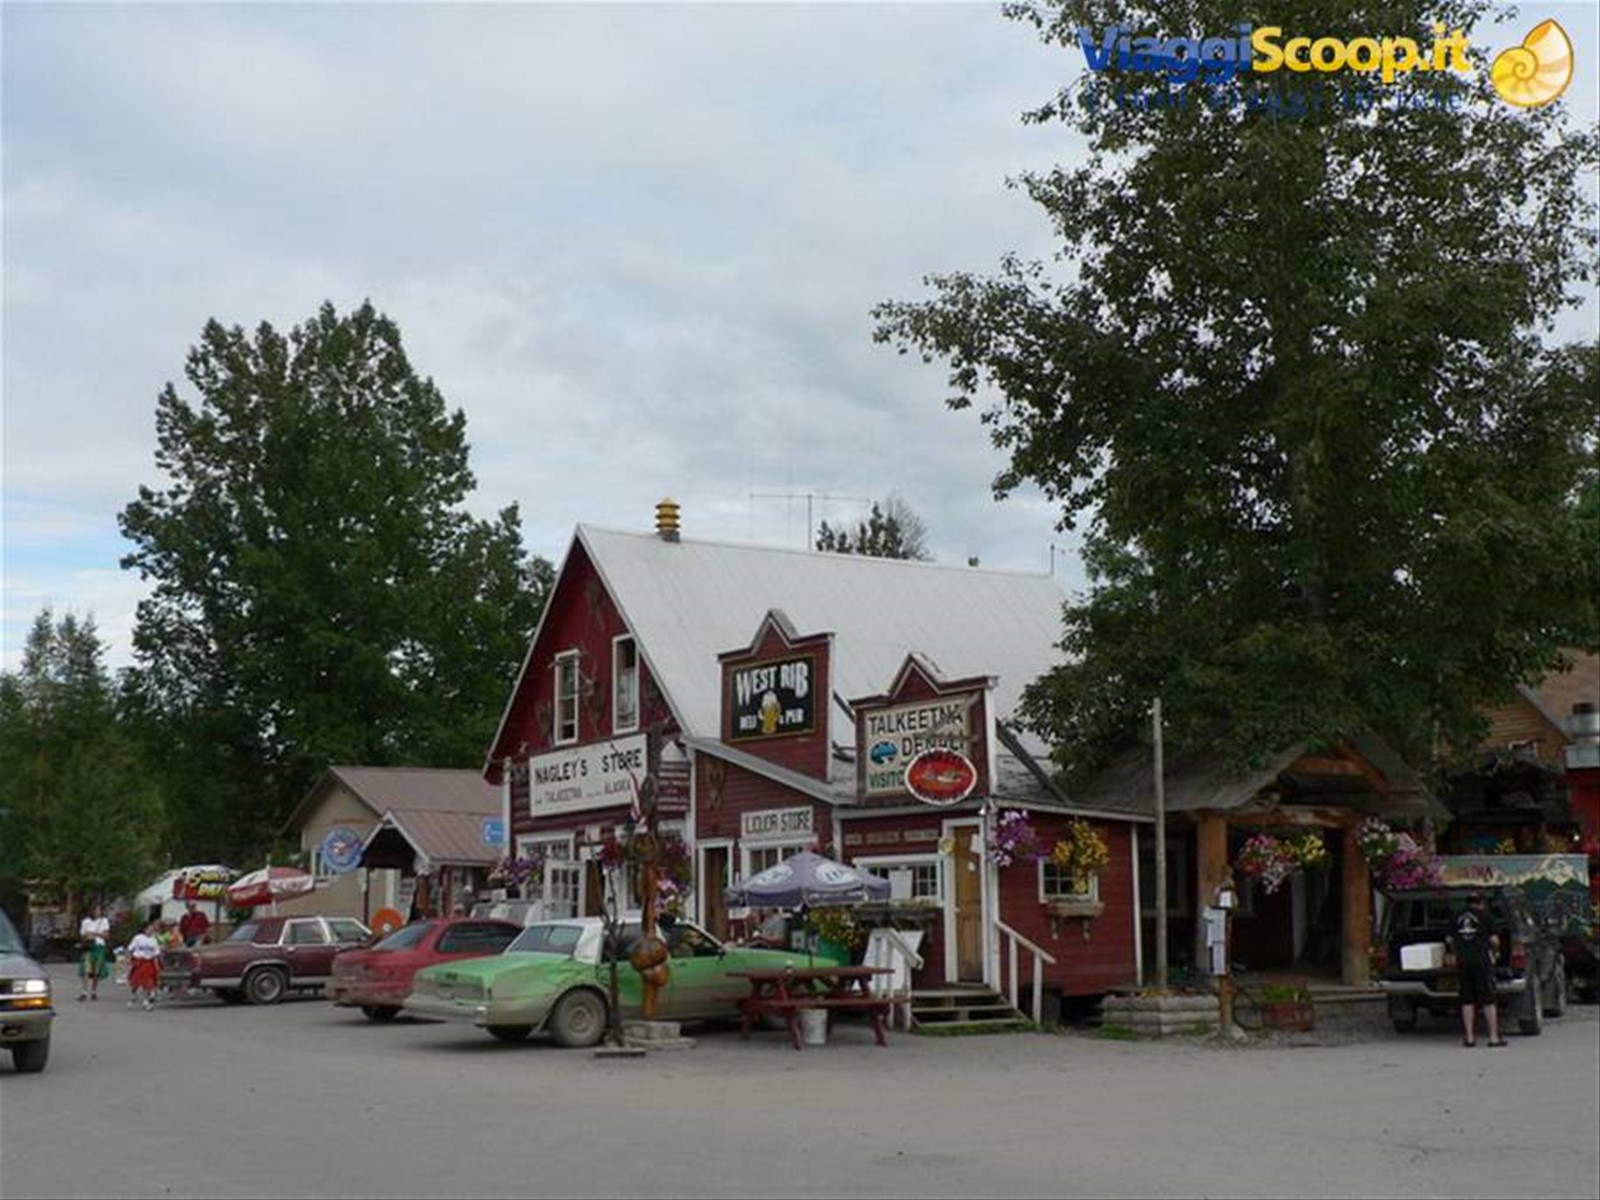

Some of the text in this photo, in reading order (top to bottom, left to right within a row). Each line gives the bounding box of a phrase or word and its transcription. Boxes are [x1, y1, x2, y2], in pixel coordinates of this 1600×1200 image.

[736, 661, 809, 706] WEST RIB
[868, 704, 964, 737] TALKEETNA
[535, 749, 642, 785] NAGLEY'S STORE
[781, 810, 811, 832] STORE
